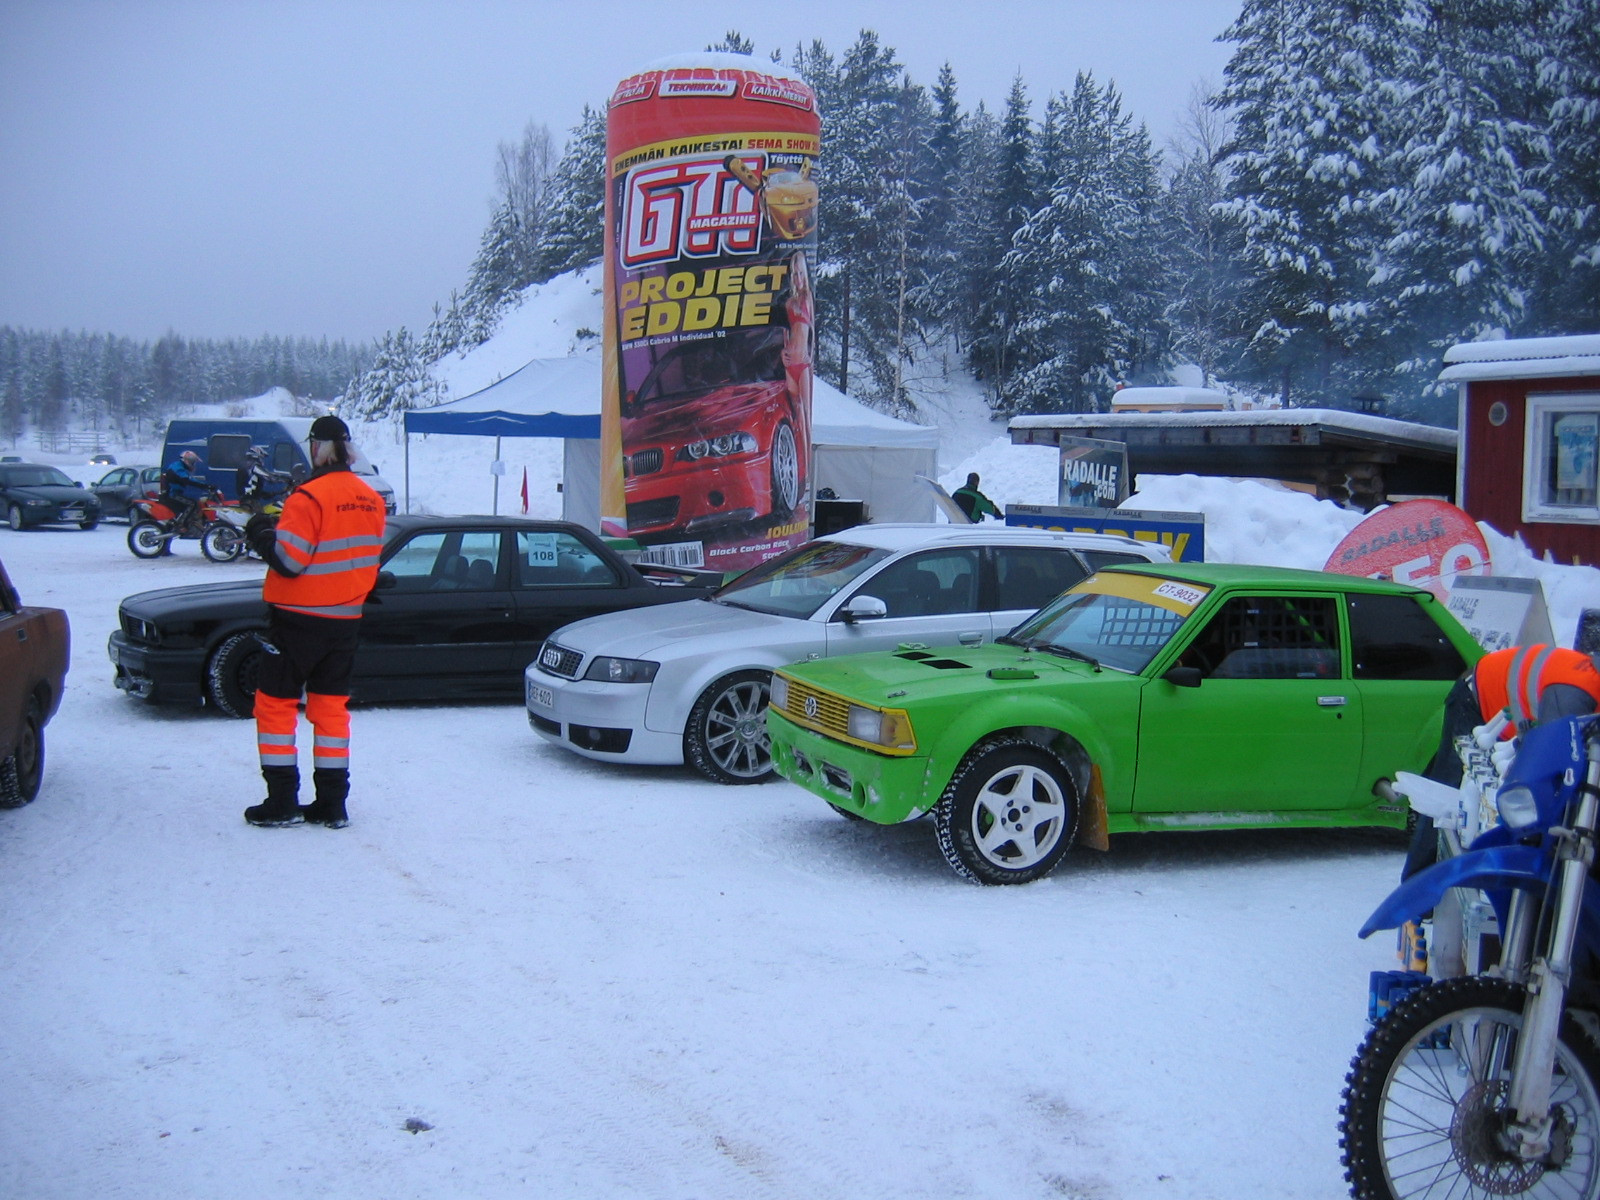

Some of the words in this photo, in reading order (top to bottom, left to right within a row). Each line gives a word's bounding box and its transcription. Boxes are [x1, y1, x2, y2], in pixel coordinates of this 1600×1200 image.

[670, 139, 742, 157] KAIKESTA!
[747, 138, 783, 150] SEMA
[690, 214, 757, 229] MAGAZINE
[620, 265, 788, 309] PROJECT
[621, 292, 773, 341] EDDIE
[680, 331, 714, 342] Individual
[1064, 459, 1117, 488] RADALLE
[1094, 483, 1116, 500] .com
[533, 551, 554, 561] 108
[709, 549, 737, 557] Black
[740, 544, 771, 553] Carbon
[1158, 584, 1200, 603] CT-9032
